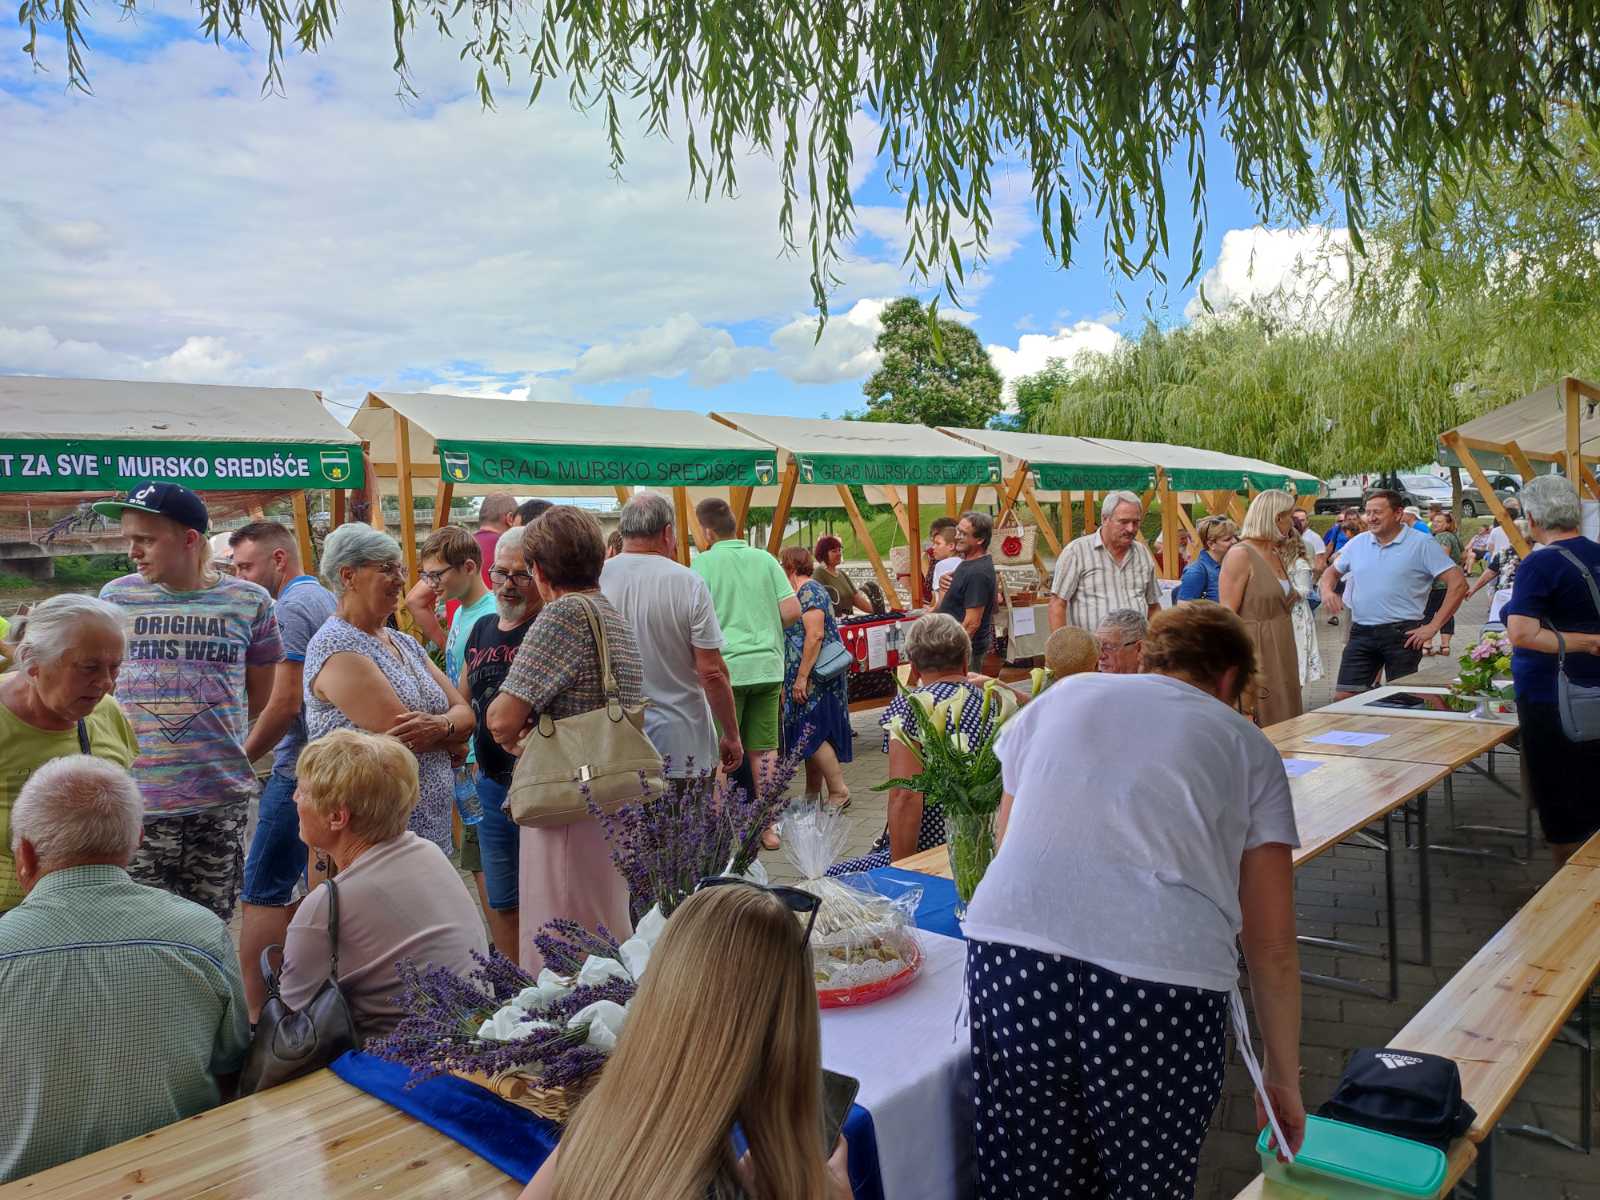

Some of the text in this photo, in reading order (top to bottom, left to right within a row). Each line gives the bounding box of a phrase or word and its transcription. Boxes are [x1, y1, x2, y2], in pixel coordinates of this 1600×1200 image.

[0, 454, 15, 477] T
[20, 454, 52, 476] ZA
[57, 454, 100, 476] SVE
[118, 456, 209, 477] MURSKO
[214, 452, 310, 477] SREDIŠĆE
[482, 458, 549, 479] GRAD
[557, 461, 650, 480] MURSKO
[134, 615, 226, 638] ORIGINAL
[185, 639, 239, 665] WEAR
[1375, 1053, 1424, 1064] adidas
